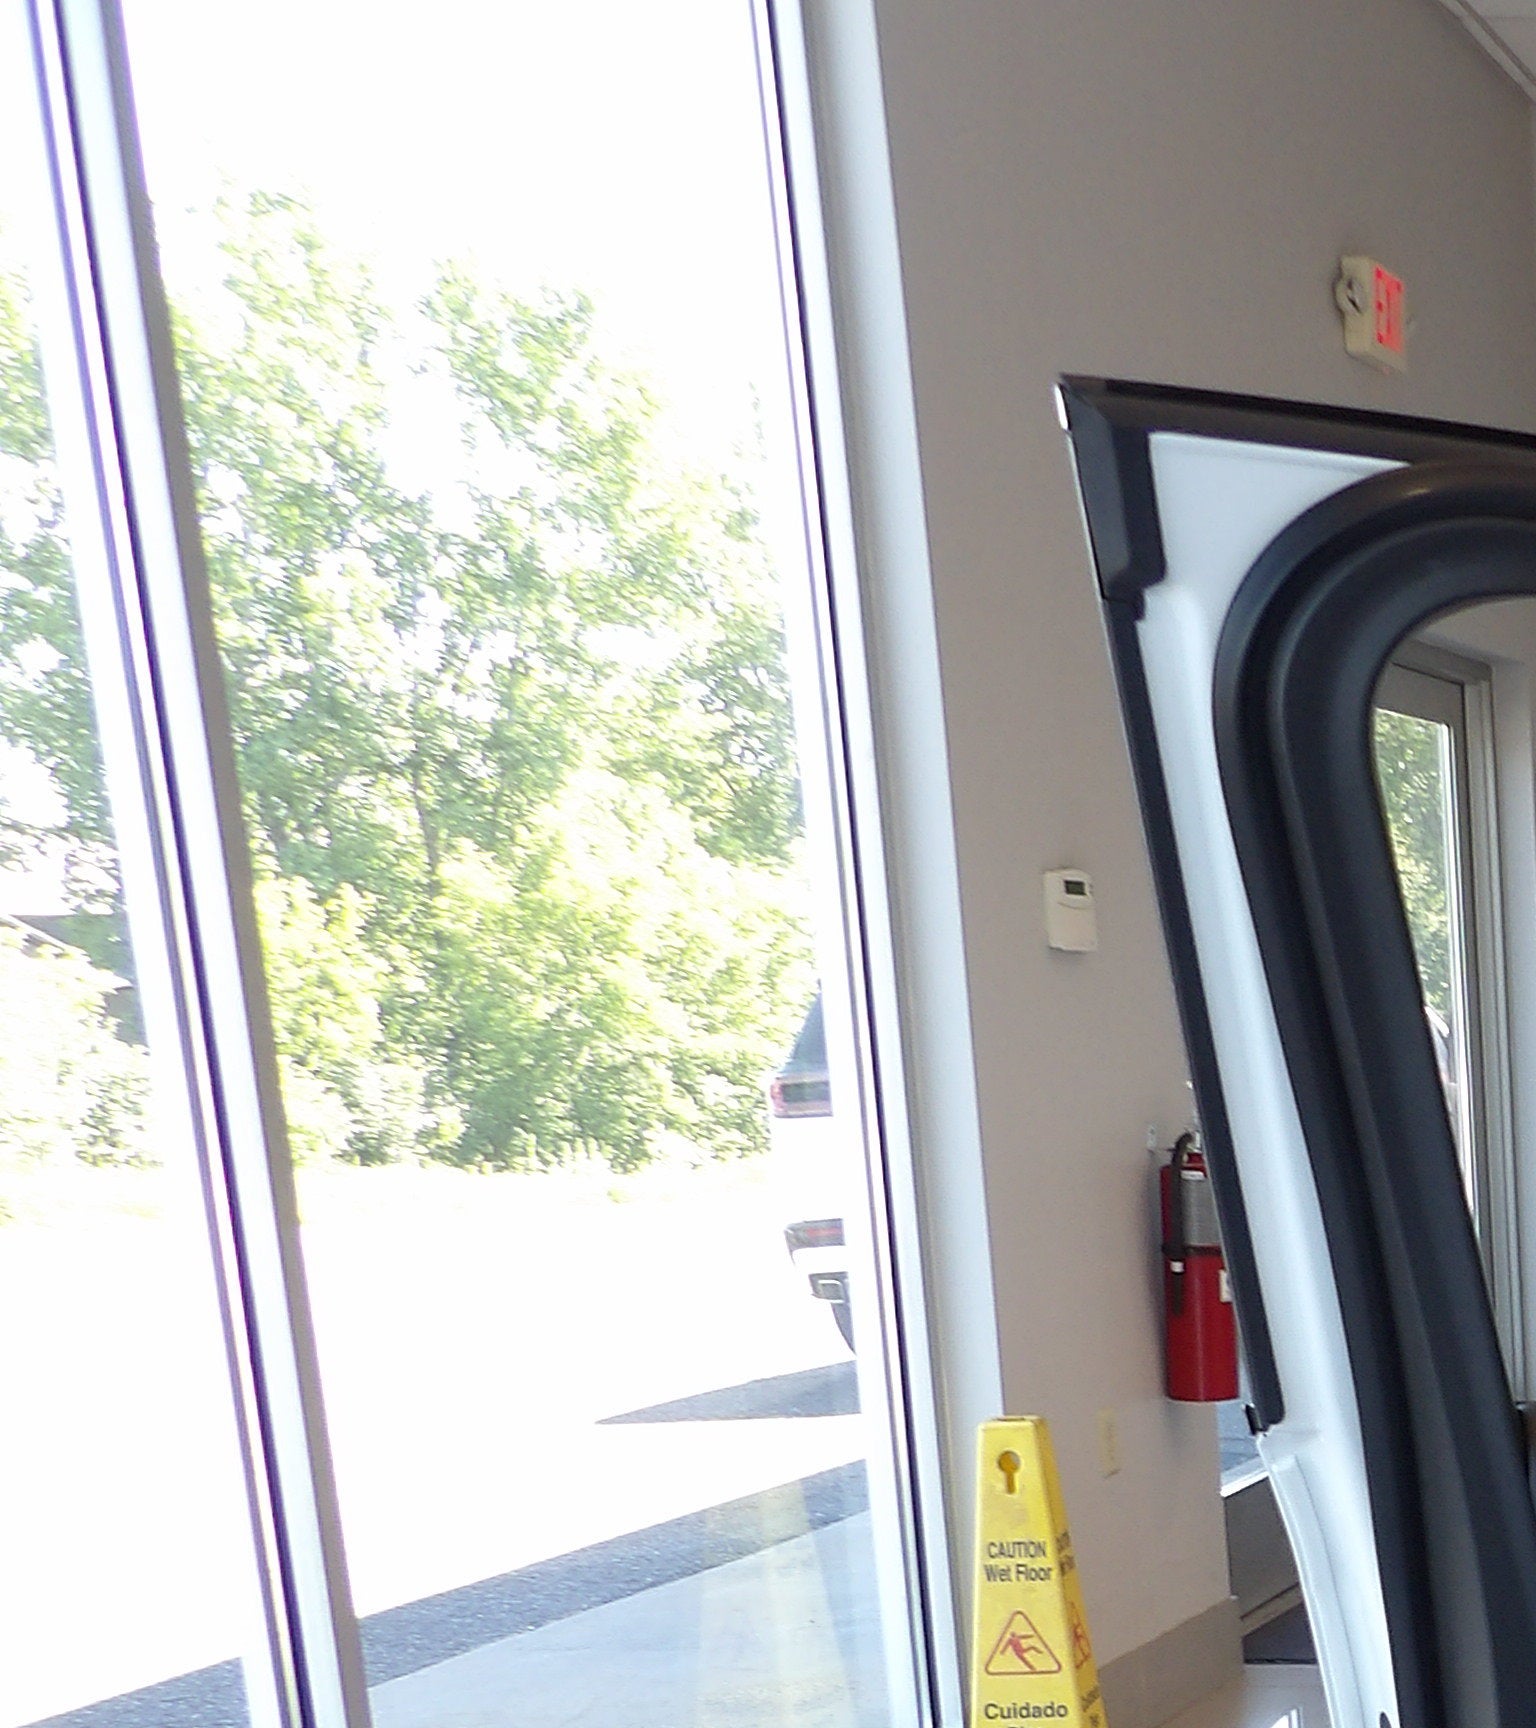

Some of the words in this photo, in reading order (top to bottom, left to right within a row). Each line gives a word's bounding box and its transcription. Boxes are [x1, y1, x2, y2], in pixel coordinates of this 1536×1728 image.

[987, 1541, 1046, 1559] CAUTION
[983, 1564, 1012, 1582] Wet
[1015, 1563, 1052, 1582] Floor
[984, 1702, 1068, 1720] Cuidado
